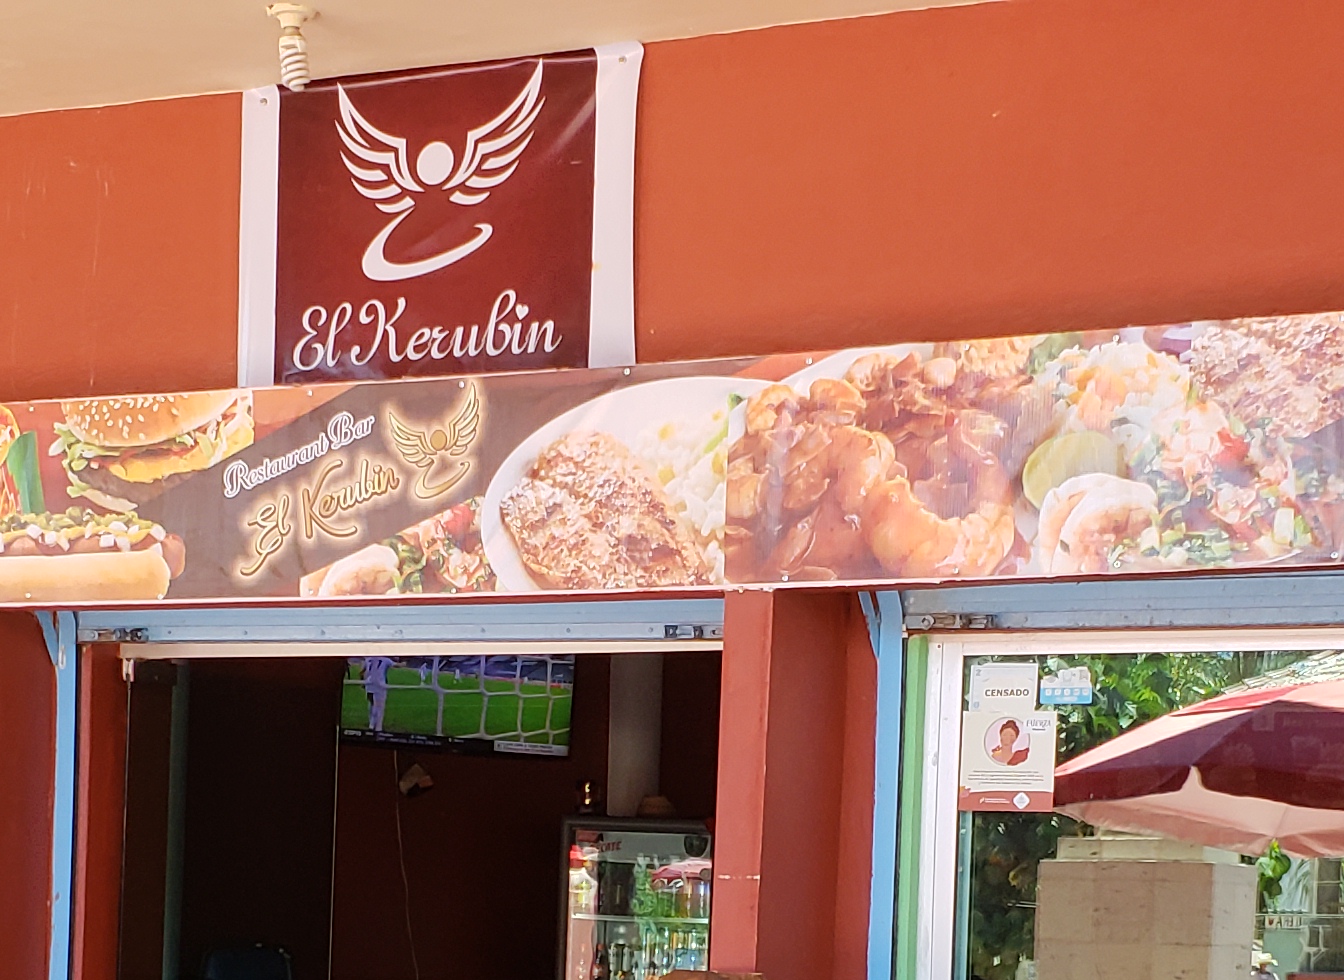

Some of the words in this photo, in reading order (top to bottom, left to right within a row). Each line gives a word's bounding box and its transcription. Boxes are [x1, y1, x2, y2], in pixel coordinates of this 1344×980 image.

[292, 302, 353, 371] El
[350, 289, 563, 367] Kerubin
[223, 431, 330, 499] Restaurant
[328, 411, 376, 450] Bar
[240, 494, 292, 577] El
[301, 458, 400, 539] Kerubin
[984, 688, 1030, 697] CENSADO
